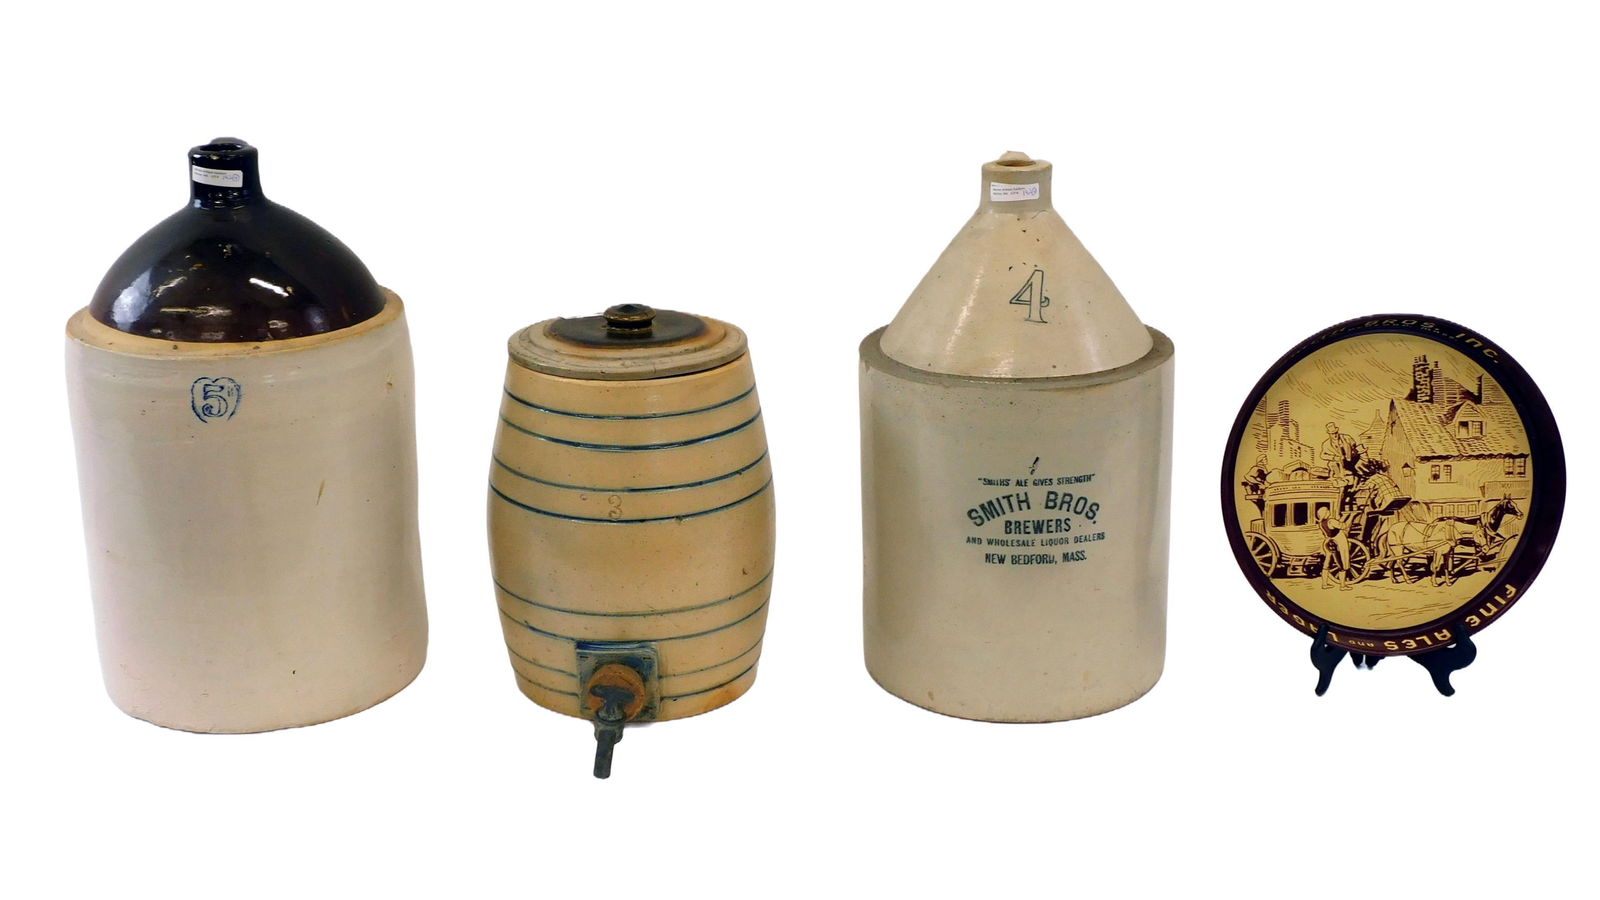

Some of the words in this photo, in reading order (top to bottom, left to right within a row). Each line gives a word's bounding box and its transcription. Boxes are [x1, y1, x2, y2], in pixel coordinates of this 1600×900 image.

[1009, 269, 1050, 323] 4
[202, 384, 228, 417] 5
[1015, 479, 1029, 487] ALE
[1033, 478, 1053, 487] GIVES
[1057, 473, 1096, 486] STRENGTH"
[608, 494, 623, 520] 3
[967, 492, 1031, 527] SMITH
[1044, 491, 1100, 525] BROS.
[1004, 518, 1071, 535] BREWERS
[966, 536, 983, 545] AND
[987, 537, 1036, 547] WHOLESALE
[1041, 537, 1069, 547] LIQUOR
[1074, 532, 1106, 545] DEALERS
[985, 553, 1006, 565] NEW
[1011, 553, 1058, 565] BEDFORD,
[1062, 550, 1087, 563] MASS.
[1384, 629, 1452, 651] ALES
